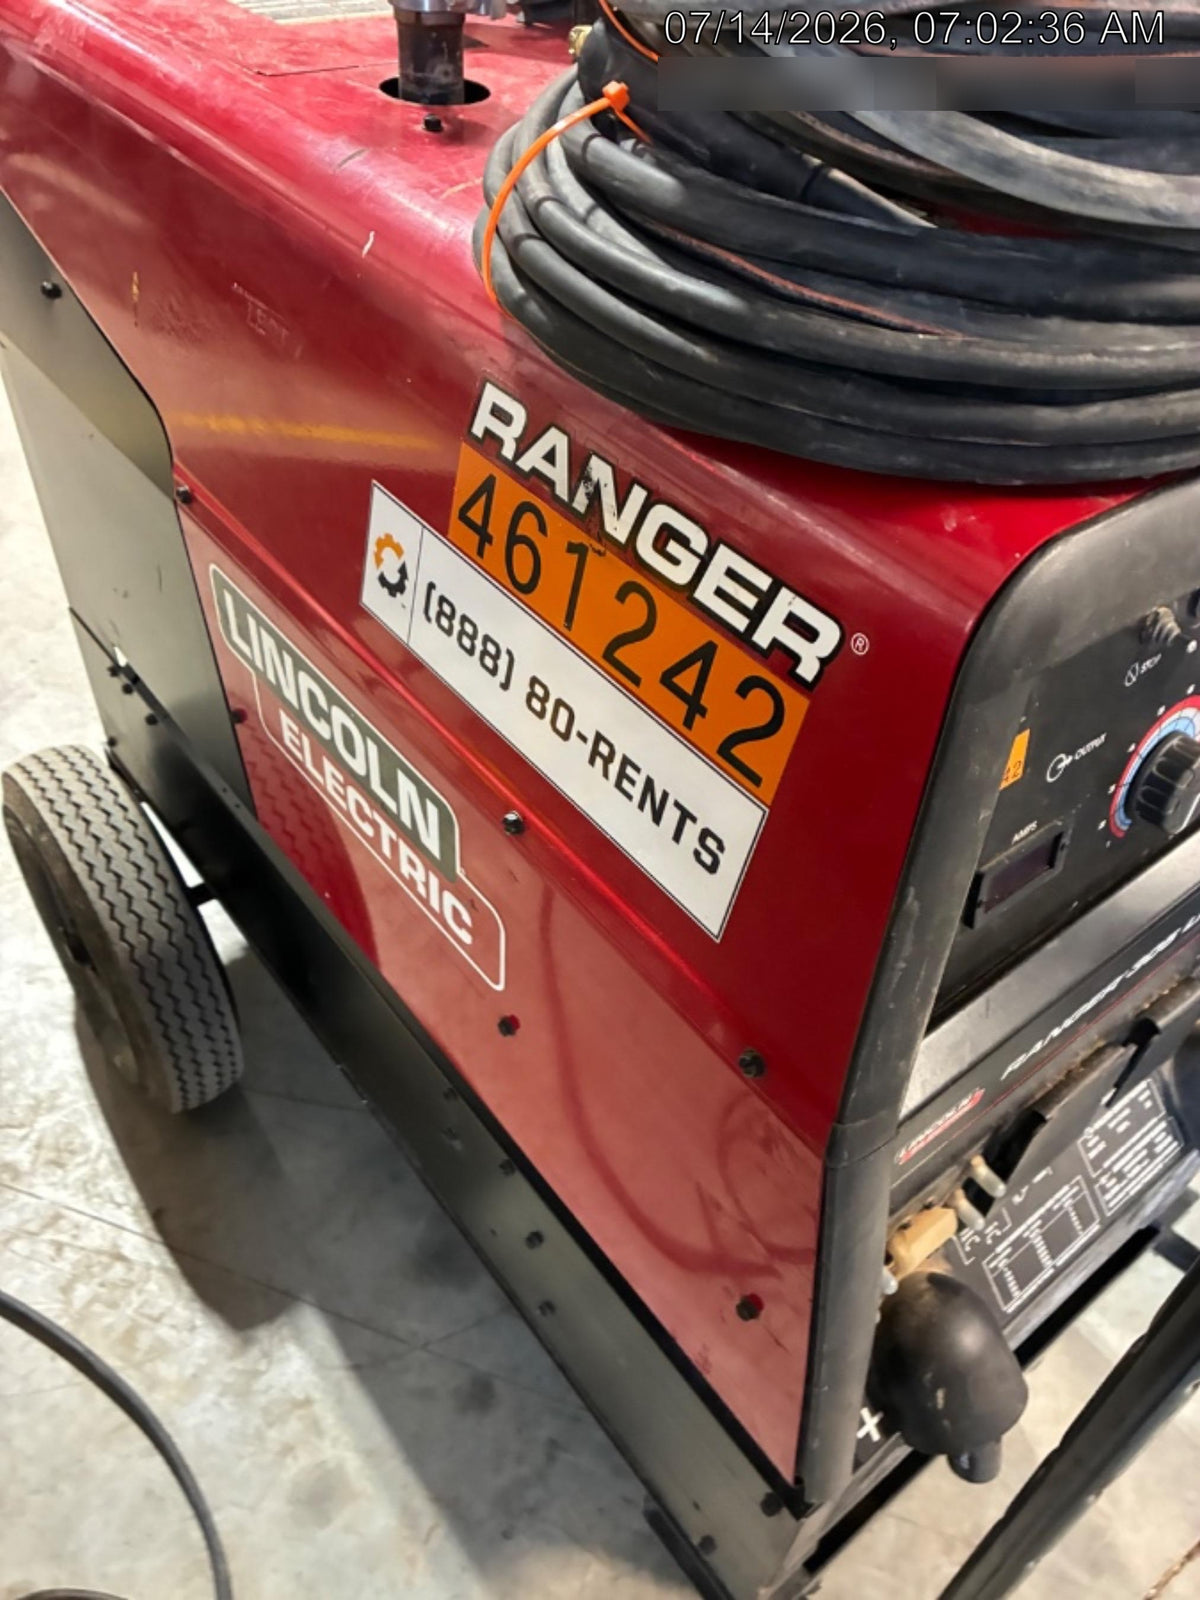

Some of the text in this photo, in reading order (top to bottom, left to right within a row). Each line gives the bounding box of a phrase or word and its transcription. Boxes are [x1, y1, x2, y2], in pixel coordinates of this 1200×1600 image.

[457, 474, 786, 788] 461242
[470, 380, 843, 690] RANGER
[222, 588, 441, 861] LINCOLN
[279, 709, 474, 945] ELECTRIC
[422, 582, 727, 876] (888) 80-RENTS
